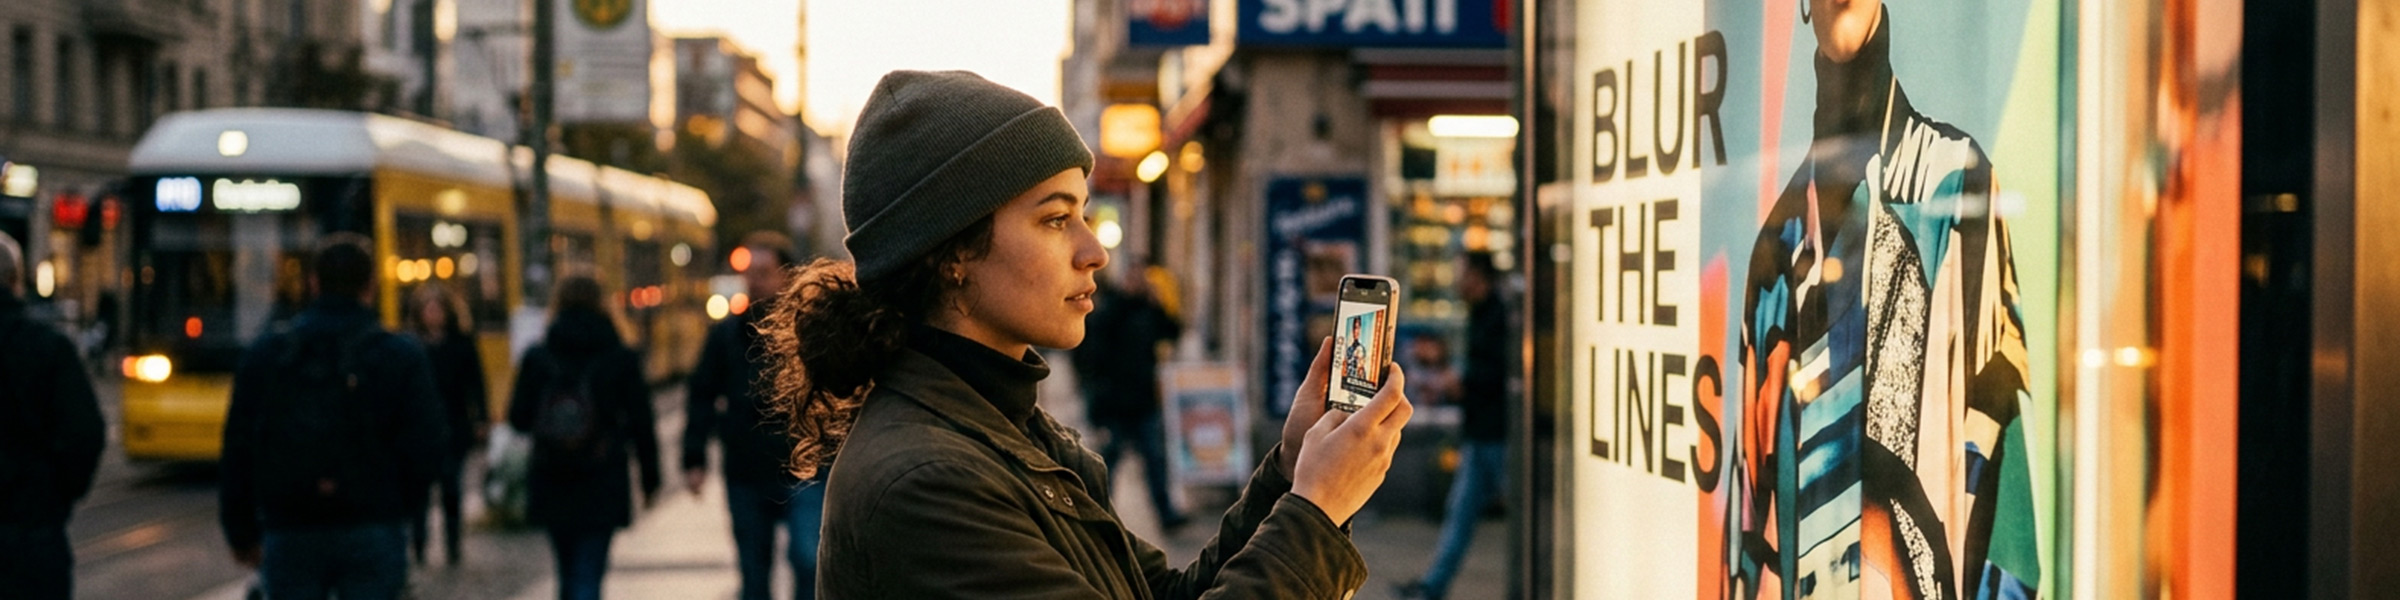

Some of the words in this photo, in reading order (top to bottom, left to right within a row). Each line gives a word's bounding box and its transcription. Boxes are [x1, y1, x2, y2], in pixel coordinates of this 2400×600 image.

[1592, 30, 1727, 184] BLUR
[1590, 199, 1678, 327] THE
[1590, 346, 1723, 494] LINES
